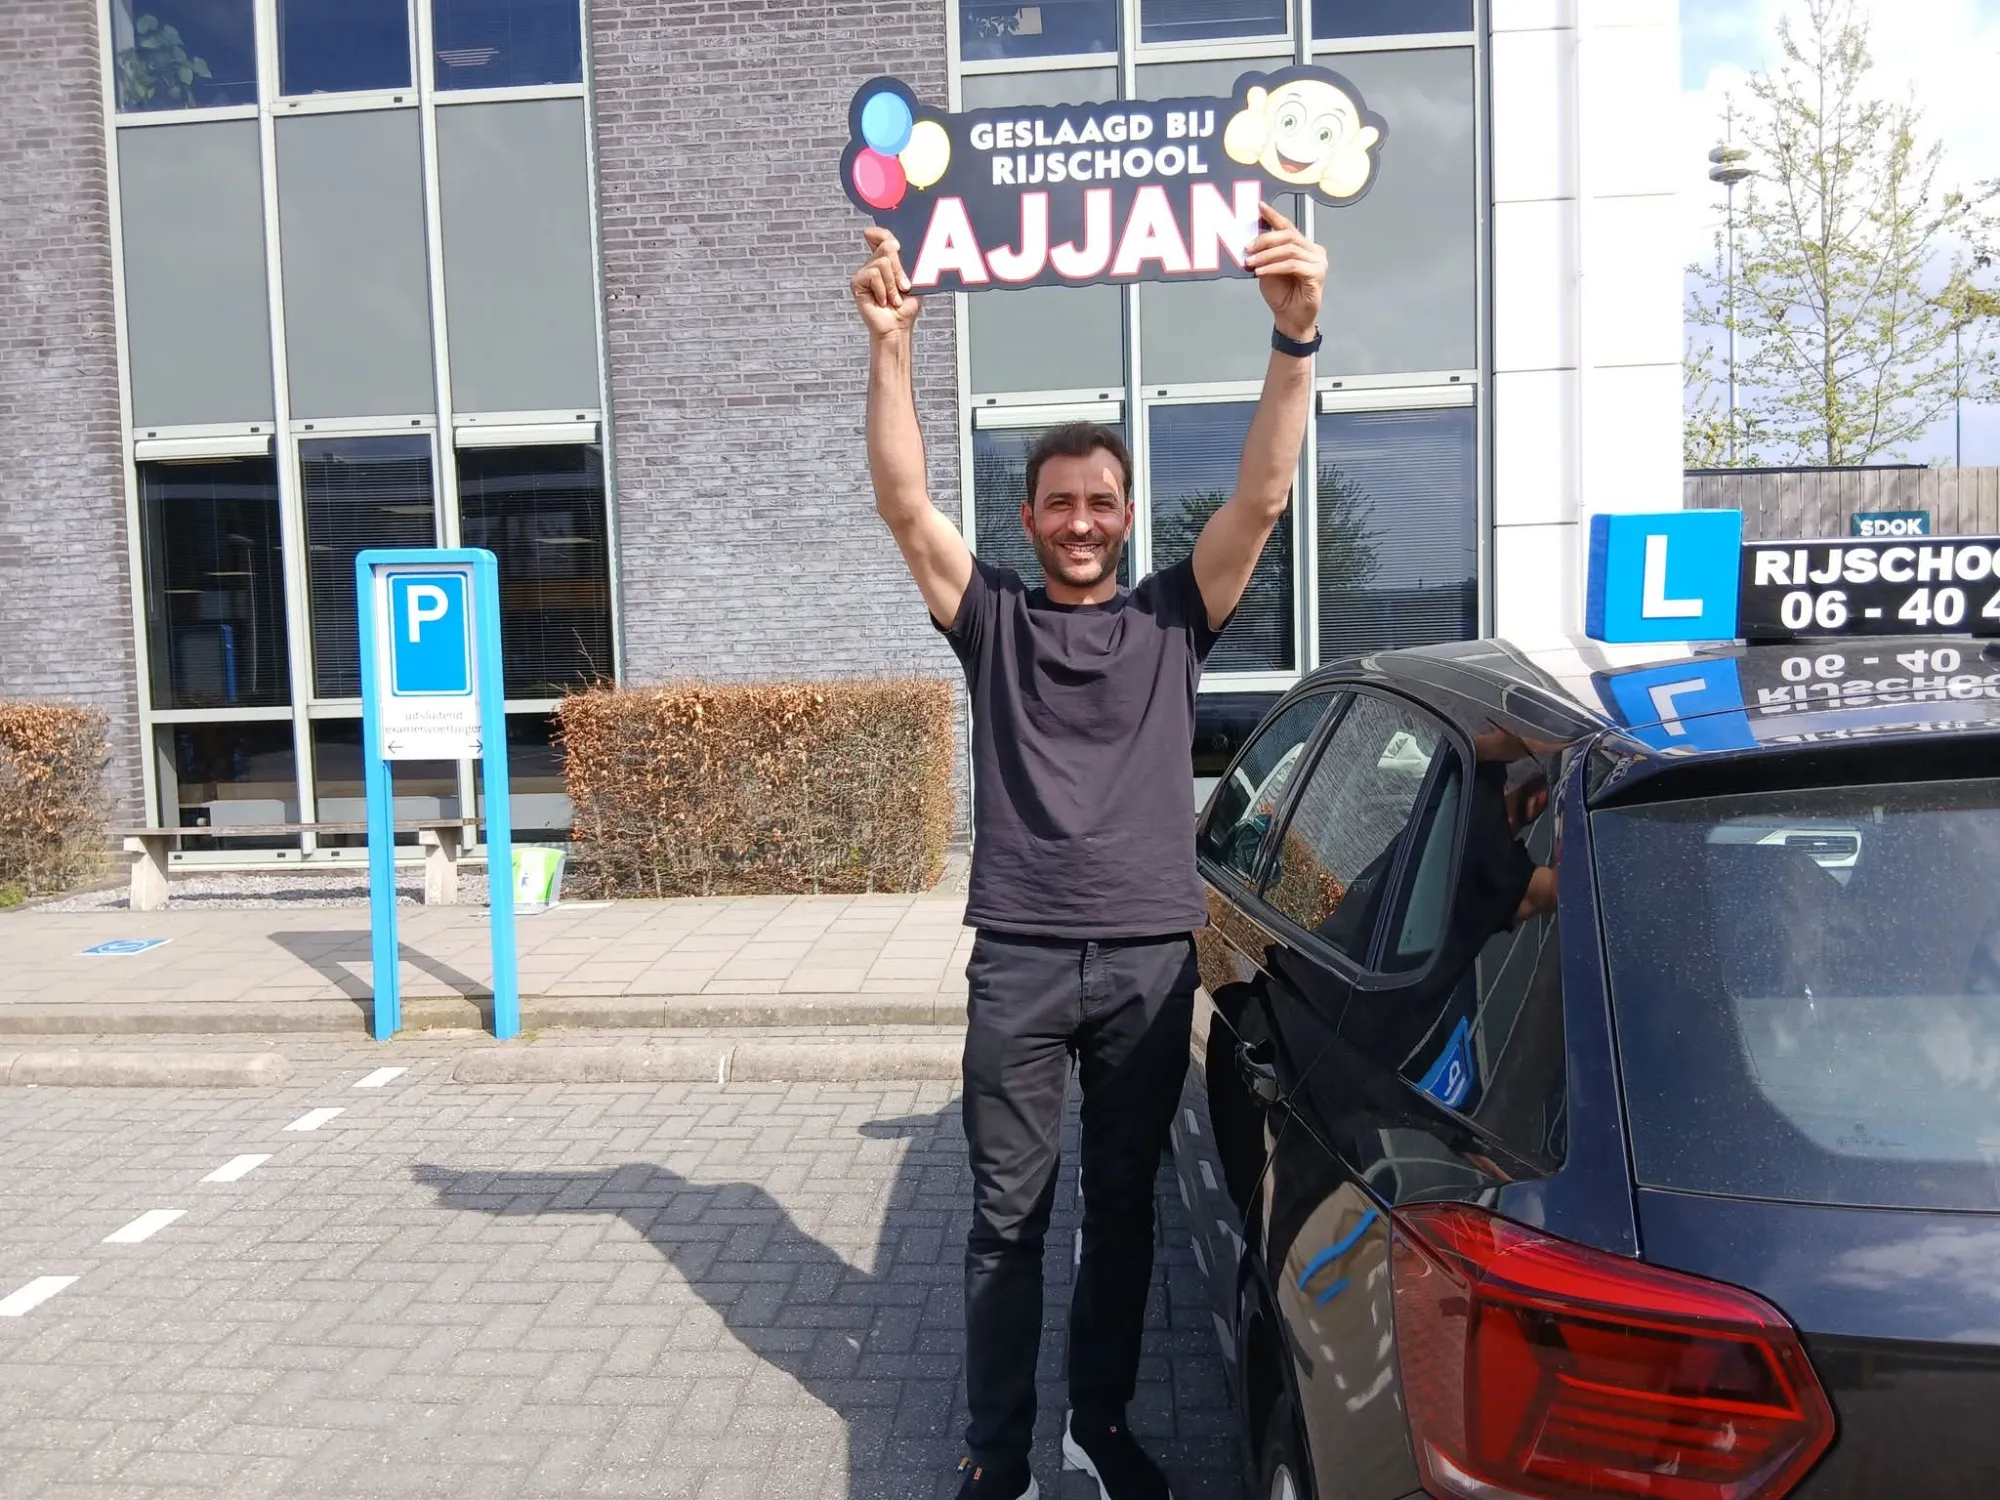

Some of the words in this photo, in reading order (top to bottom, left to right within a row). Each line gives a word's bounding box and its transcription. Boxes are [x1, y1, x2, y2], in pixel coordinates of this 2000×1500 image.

[970, 115, 1153, 150] GESLAAGD
[1167, 110, 1216, 139] BIJ
[991, 145, 1208, 185] RIJSCHOOL
[910, 179, 1263, 287] AJJAN
[1860, 518, 1922, 536] SDOK
[1642, 534, 1704, 619] L
[1754, 545, 2000, 586] RIJSCHO
[407, 585, 449, 643] P
[1781, 591, 1848, 629] 06
[1898, 587, 1966, 625] 40
